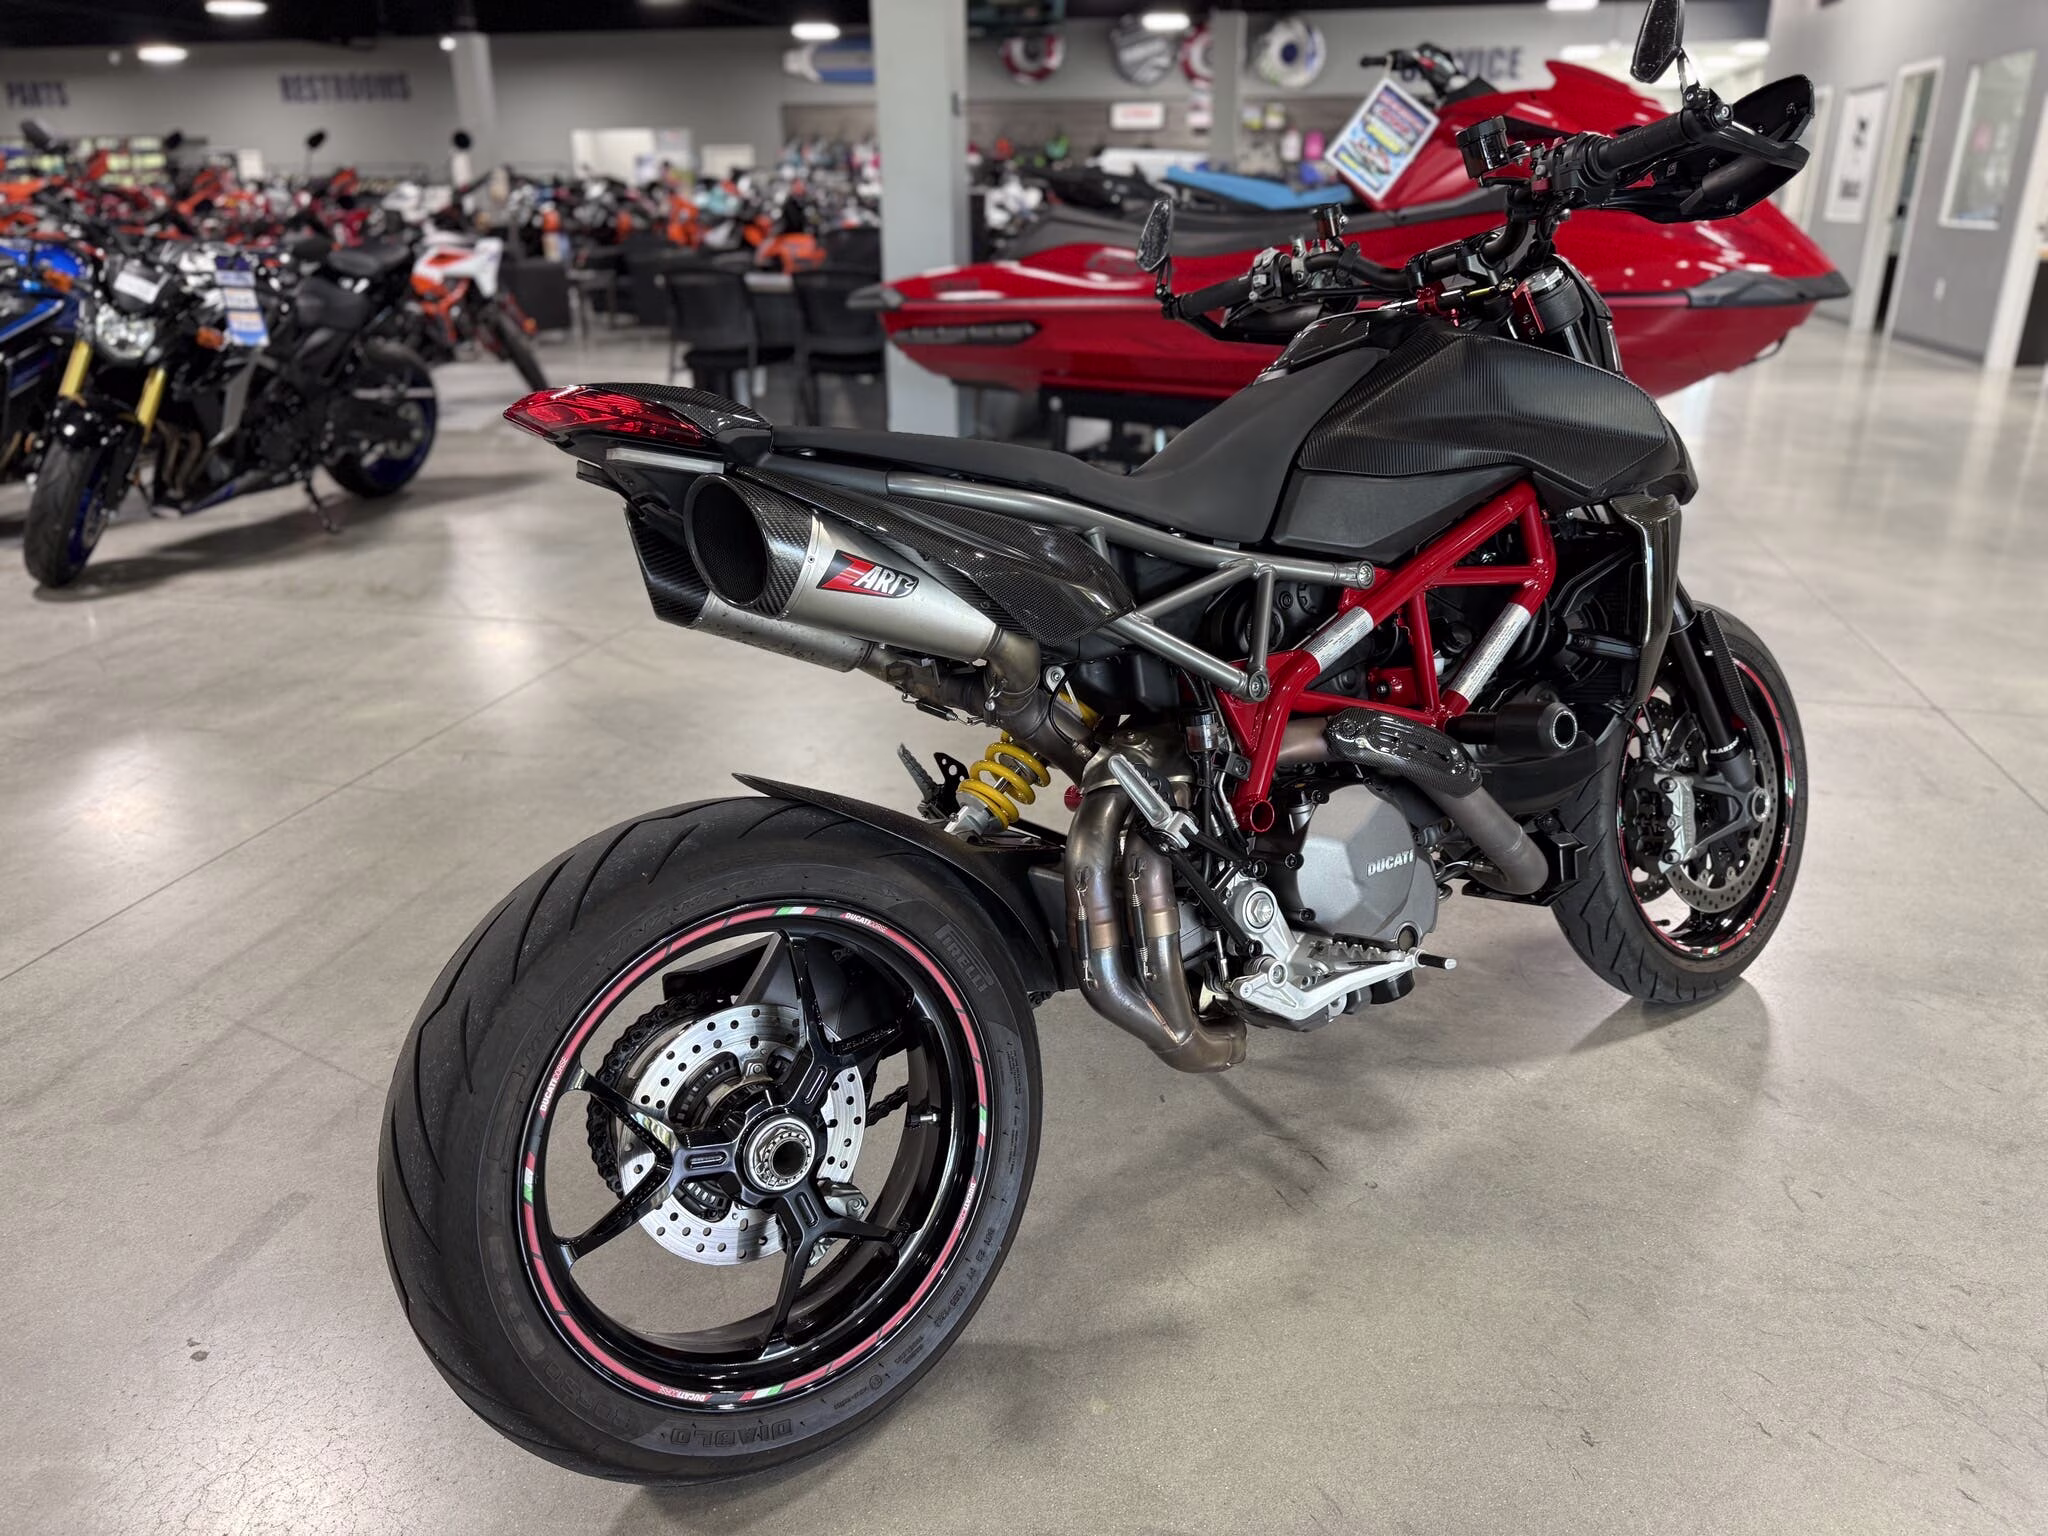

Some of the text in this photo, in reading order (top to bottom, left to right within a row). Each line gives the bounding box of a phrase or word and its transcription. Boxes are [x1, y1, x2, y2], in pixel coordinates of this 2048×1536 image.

[1366, 848, 1414, 876] DUCATI
[935, 923, 994, 992] PIRELLI
[670, 1418, 793, 1448] DIABLO
